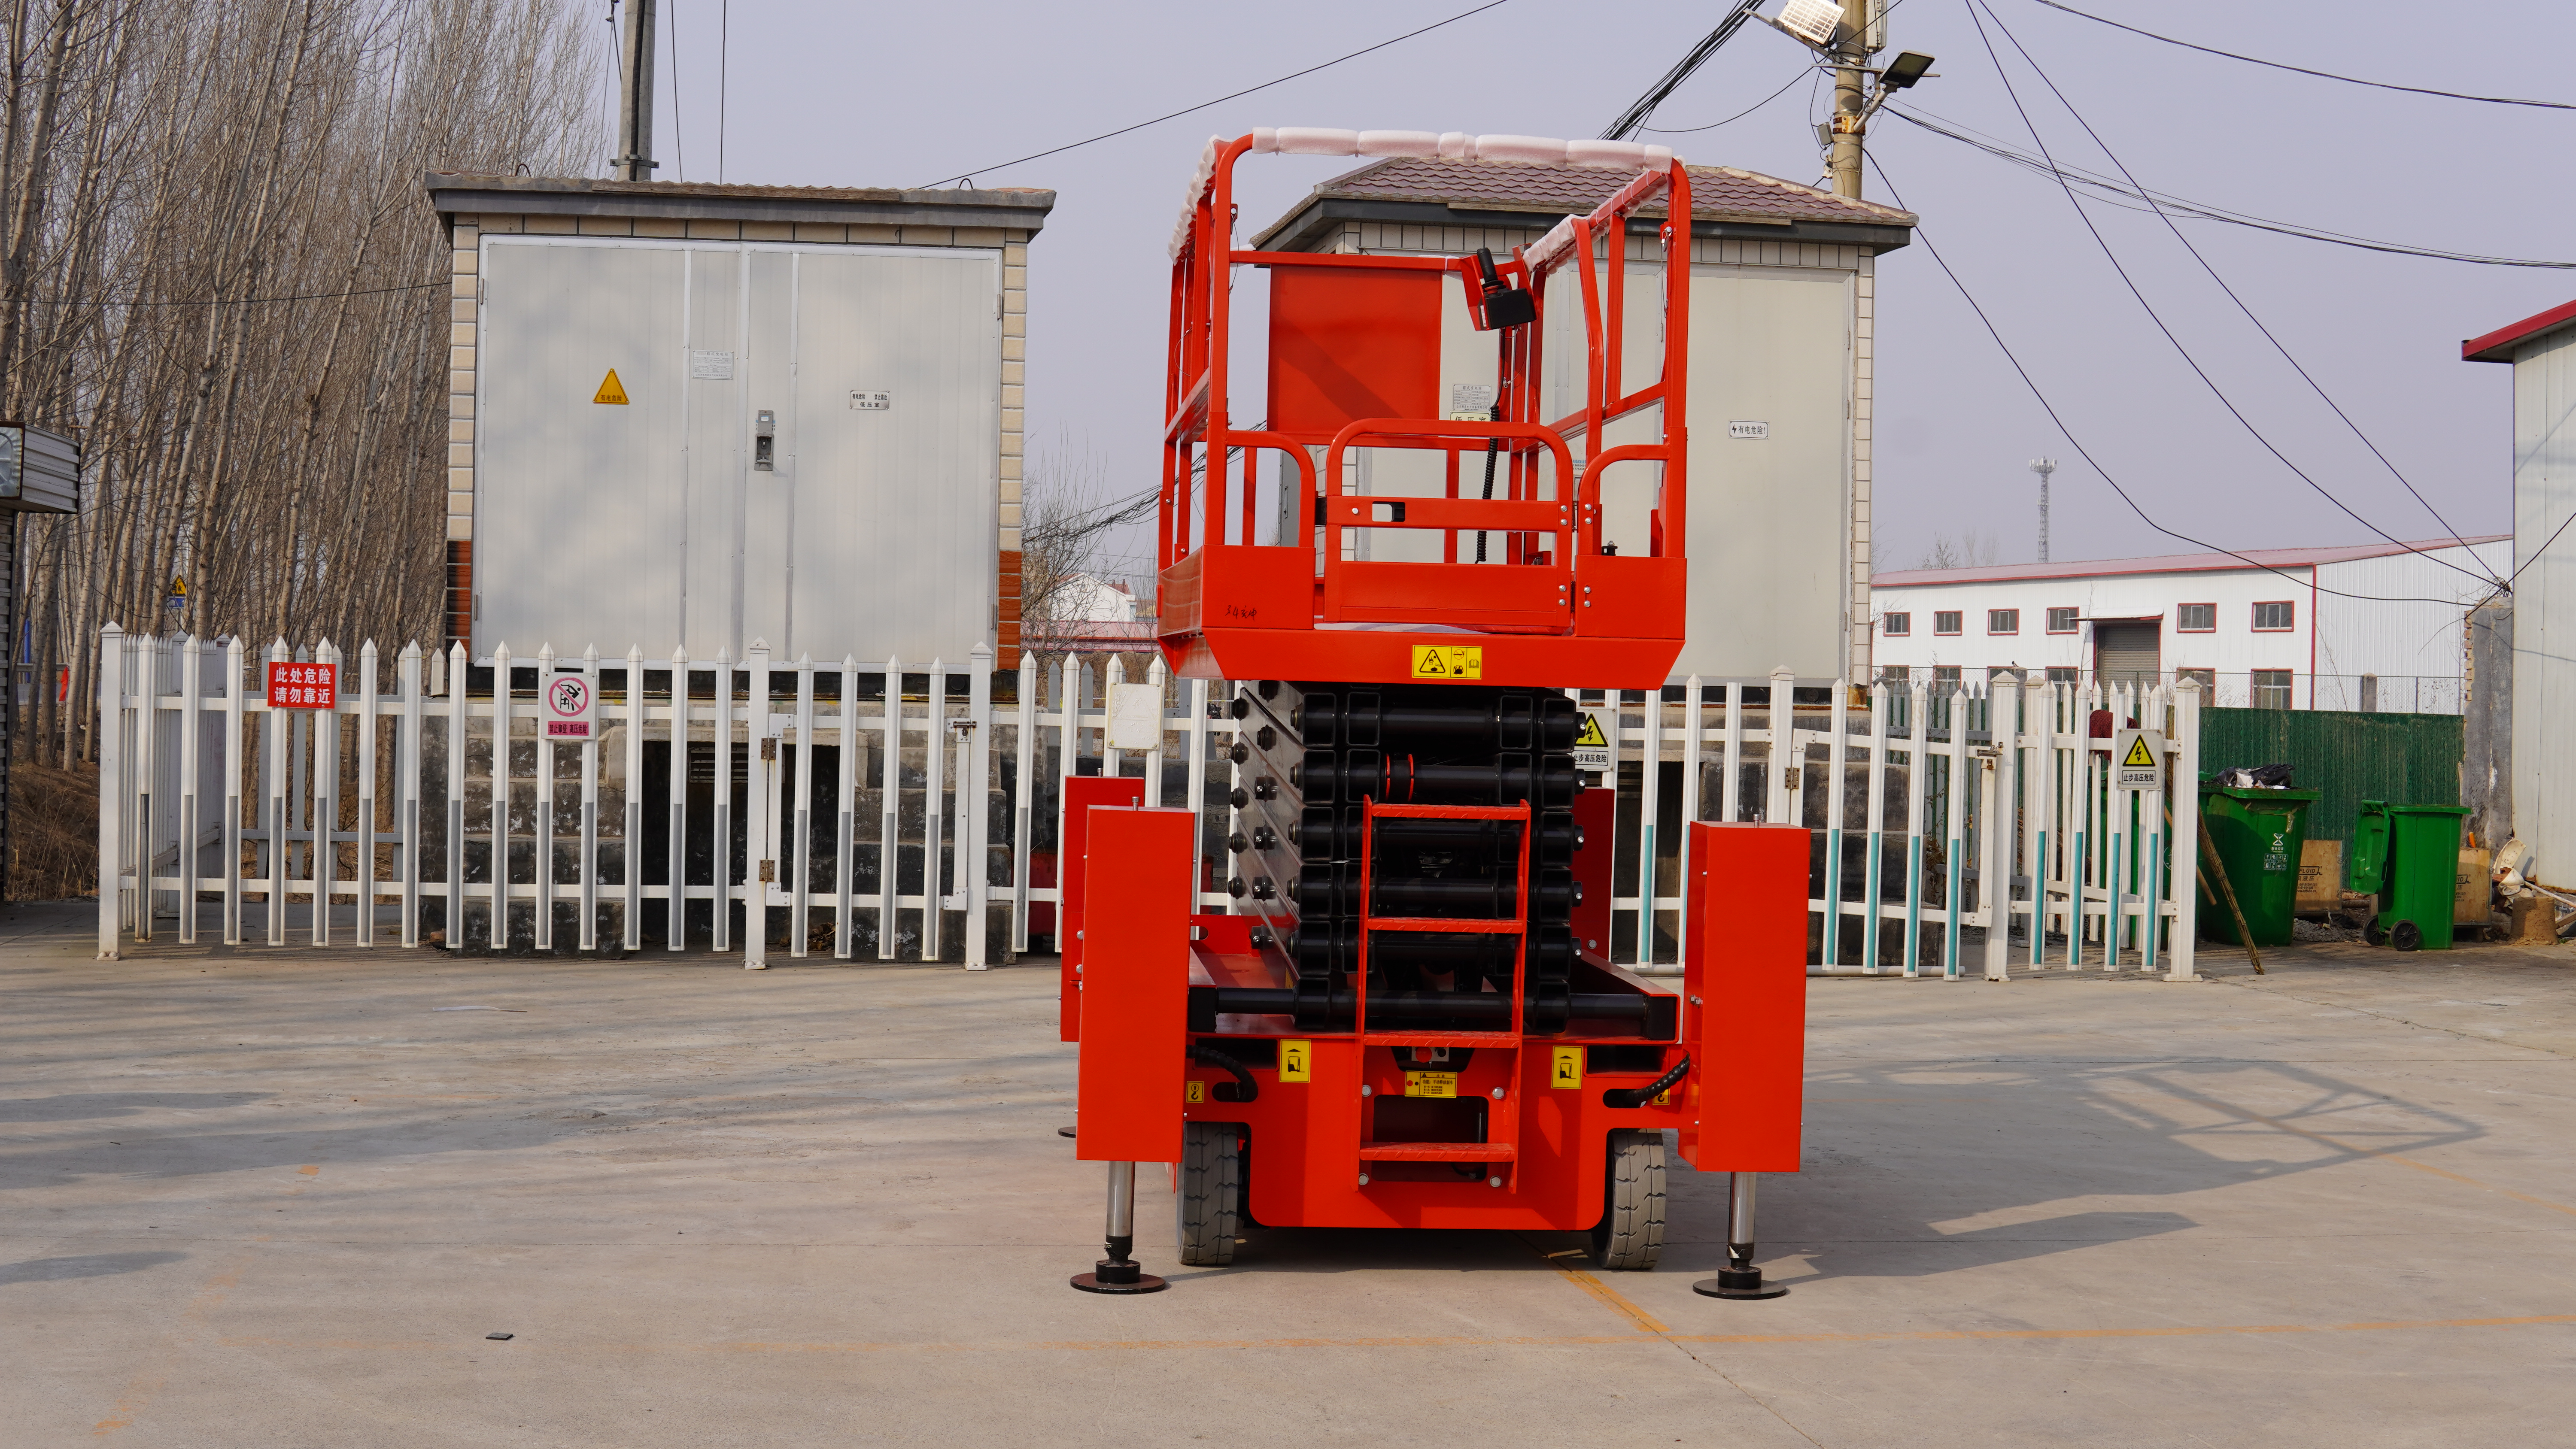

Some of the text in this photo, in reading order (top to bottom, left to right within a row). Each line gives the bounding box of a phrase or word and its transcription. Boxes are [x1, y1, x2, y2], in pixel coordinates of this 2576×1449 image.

[275, 667, 331, 684] 此处危险
[274, 686, 330, 703] 请勿靠近
[549, 724, 587, 734] 禁止攀登 高压危险
[1574, 754, 1607, 763] 止步高压危险
[2123, 773, 2154, 782] 止步高压危险
